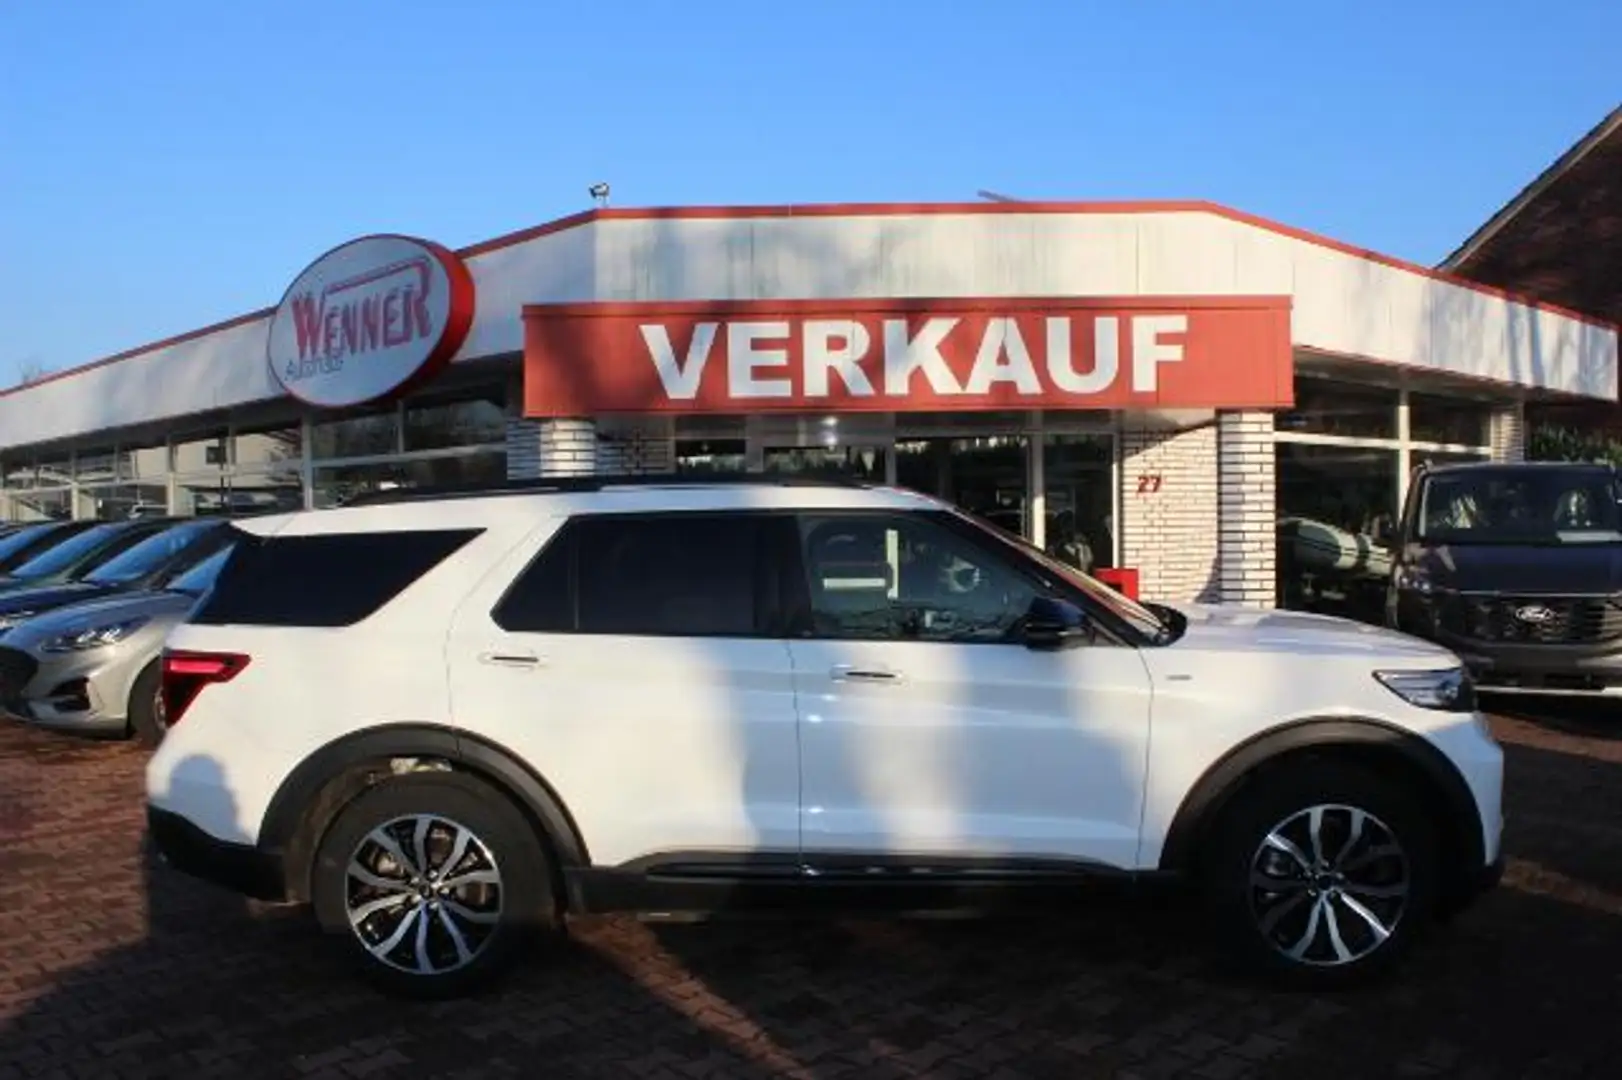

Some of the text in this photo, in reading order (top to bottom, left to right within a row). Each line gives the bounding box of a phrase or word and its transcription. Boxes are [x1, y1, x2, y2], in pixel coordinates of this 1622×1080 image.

[291, 257, 432, 359] WENNER
[640, 314, 1189, 400] VERKAUF
[1137, 475, 1162, 493] 27
